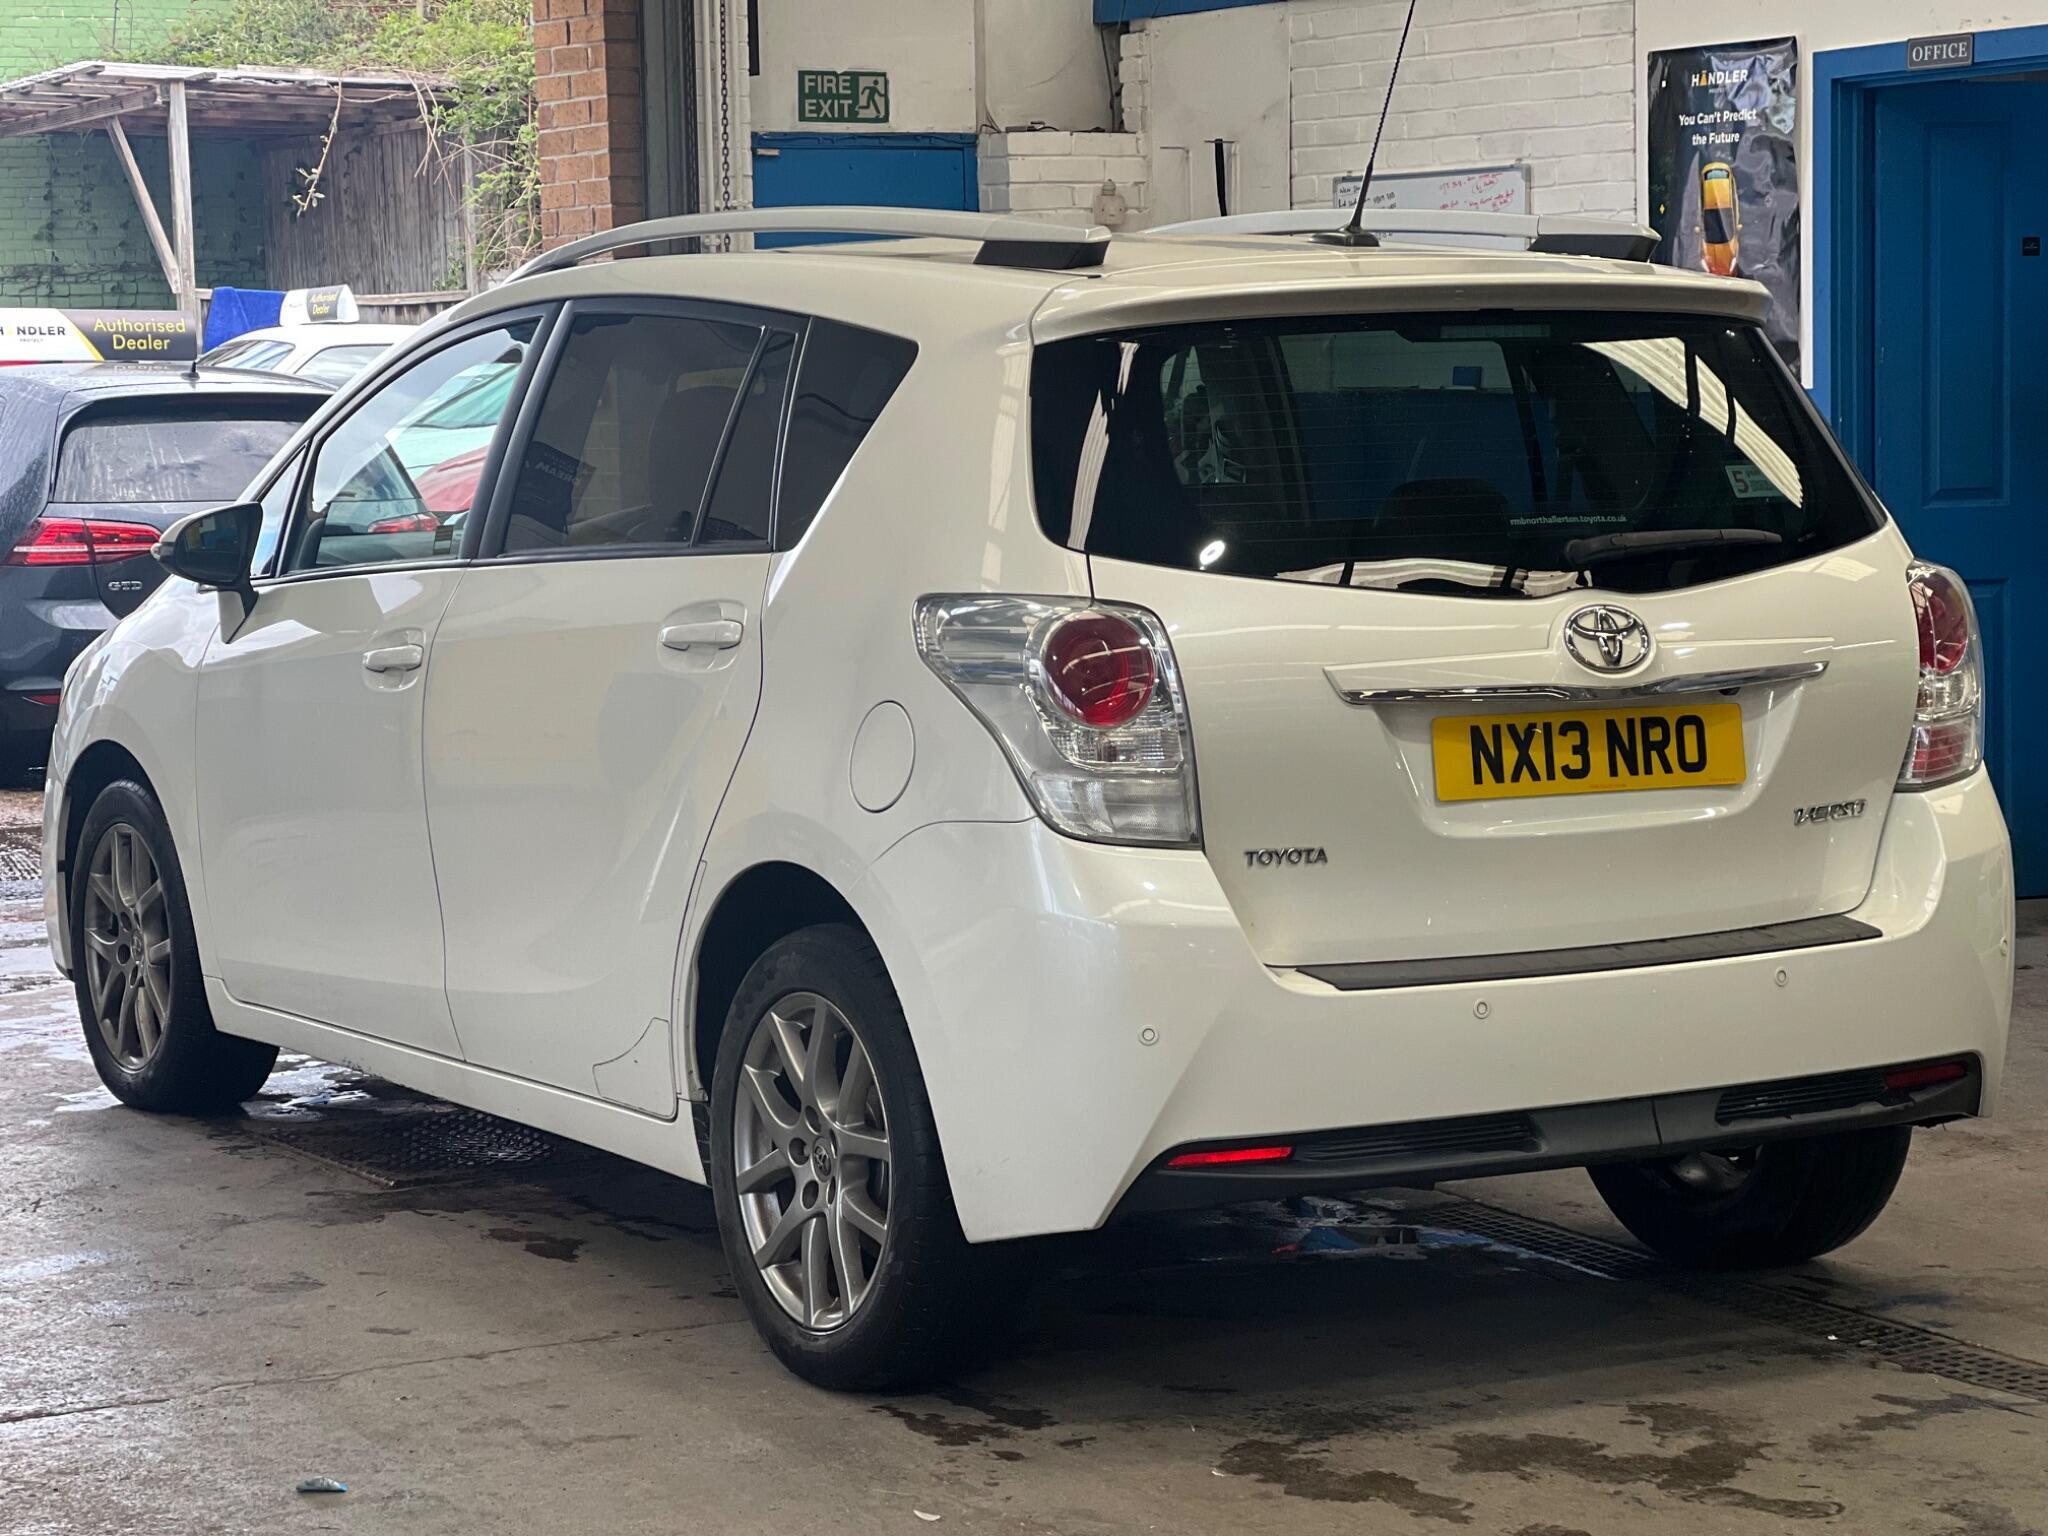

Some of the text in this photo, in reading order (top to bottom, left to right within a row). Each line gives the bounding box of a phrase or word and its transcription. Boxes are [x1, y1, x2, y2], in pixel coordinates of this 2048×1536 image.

[1912, 41, 1968, 61] OFFICE
[804, 75, 851, 94] FIRE
[805, 99, 852, 118] EXIT
[1679, 108, 1757, 126] You Can't Predict
[1692, 132, 1740, 145] the Future
[93, 318, 187, 333] Authorised
[112, 334, 170, 350] Dealer
[108, 580, 143, 591] GTD
[1470, 715, 1708, 785] NX13 NRO
[1244, 847, 1328, 867] TOYOTA
